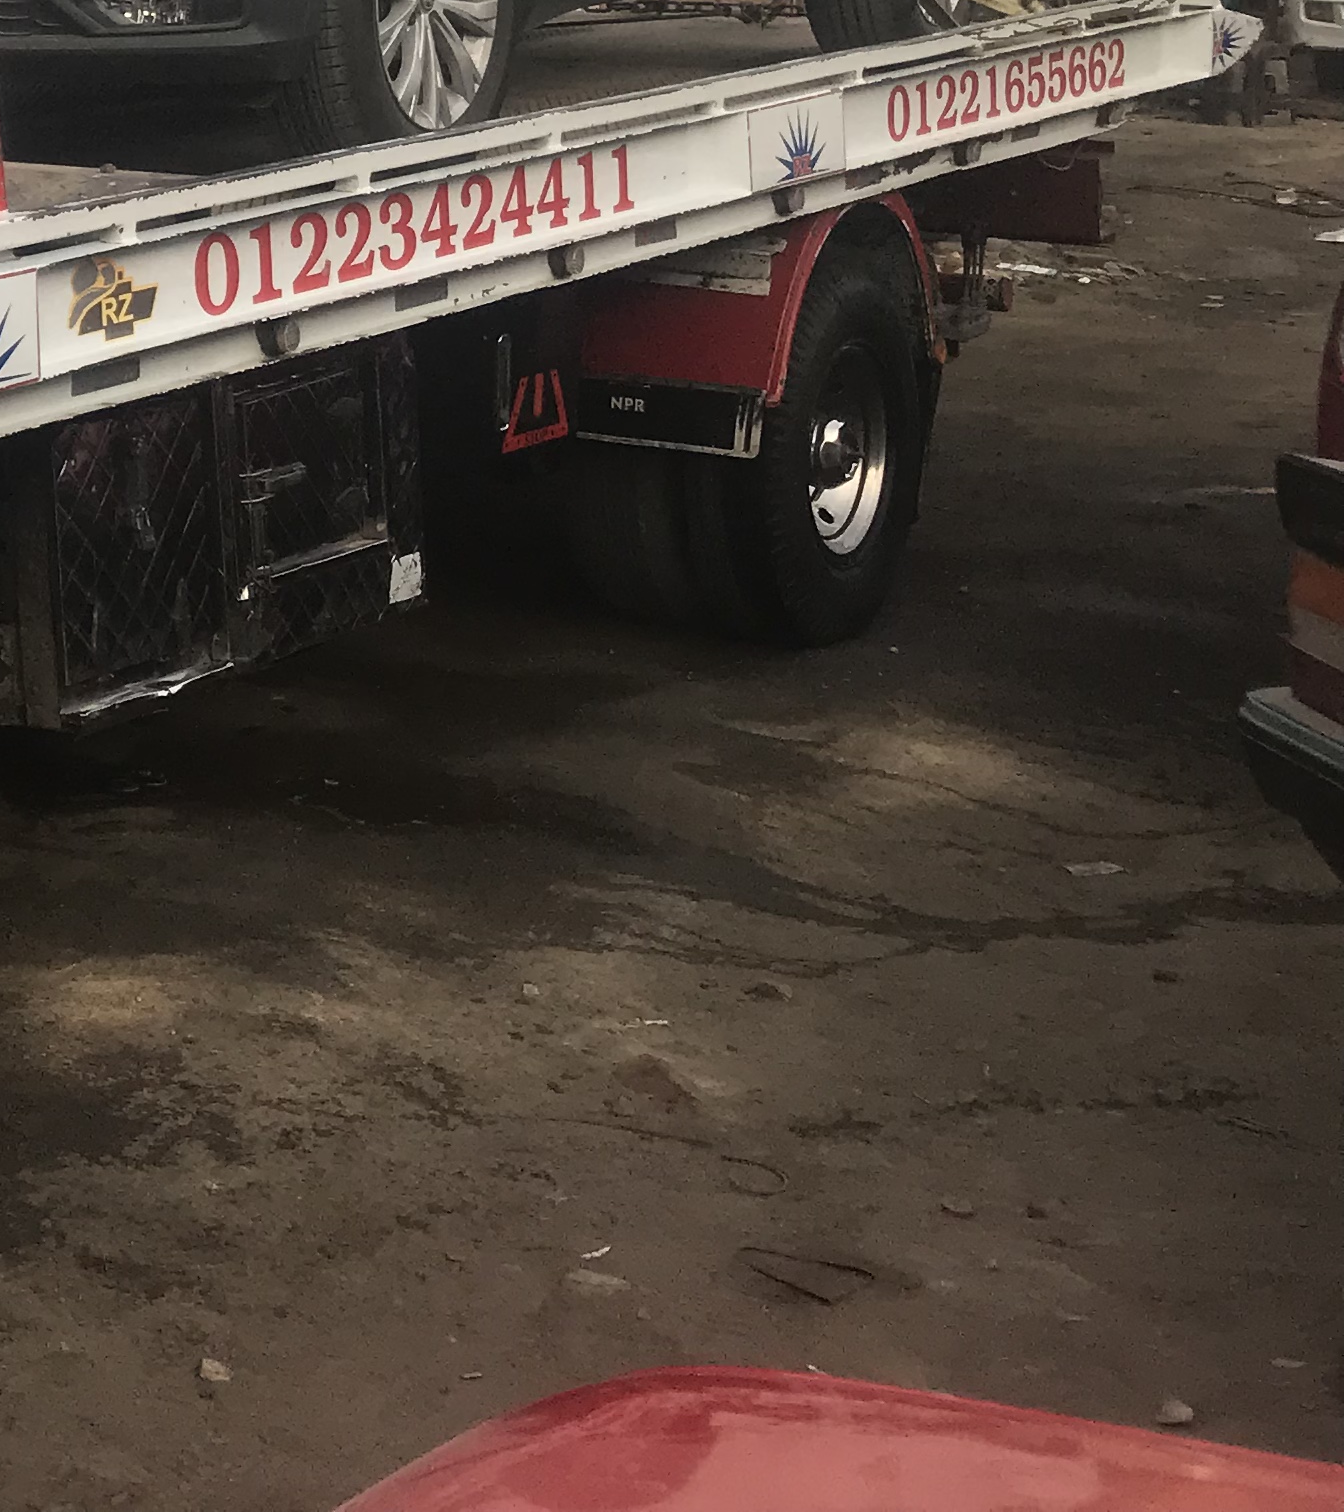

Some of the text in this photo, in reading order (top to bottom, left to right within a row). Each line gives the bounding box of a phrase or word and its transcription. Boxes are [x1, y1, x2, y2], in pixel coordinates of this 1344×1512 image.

[887, 38, 1126, 142] 01221655662
[194, 143, 635, 317] 01223424411
[100, 292, 134, 326] RZ
[610, 395, 645, 413] NPR
